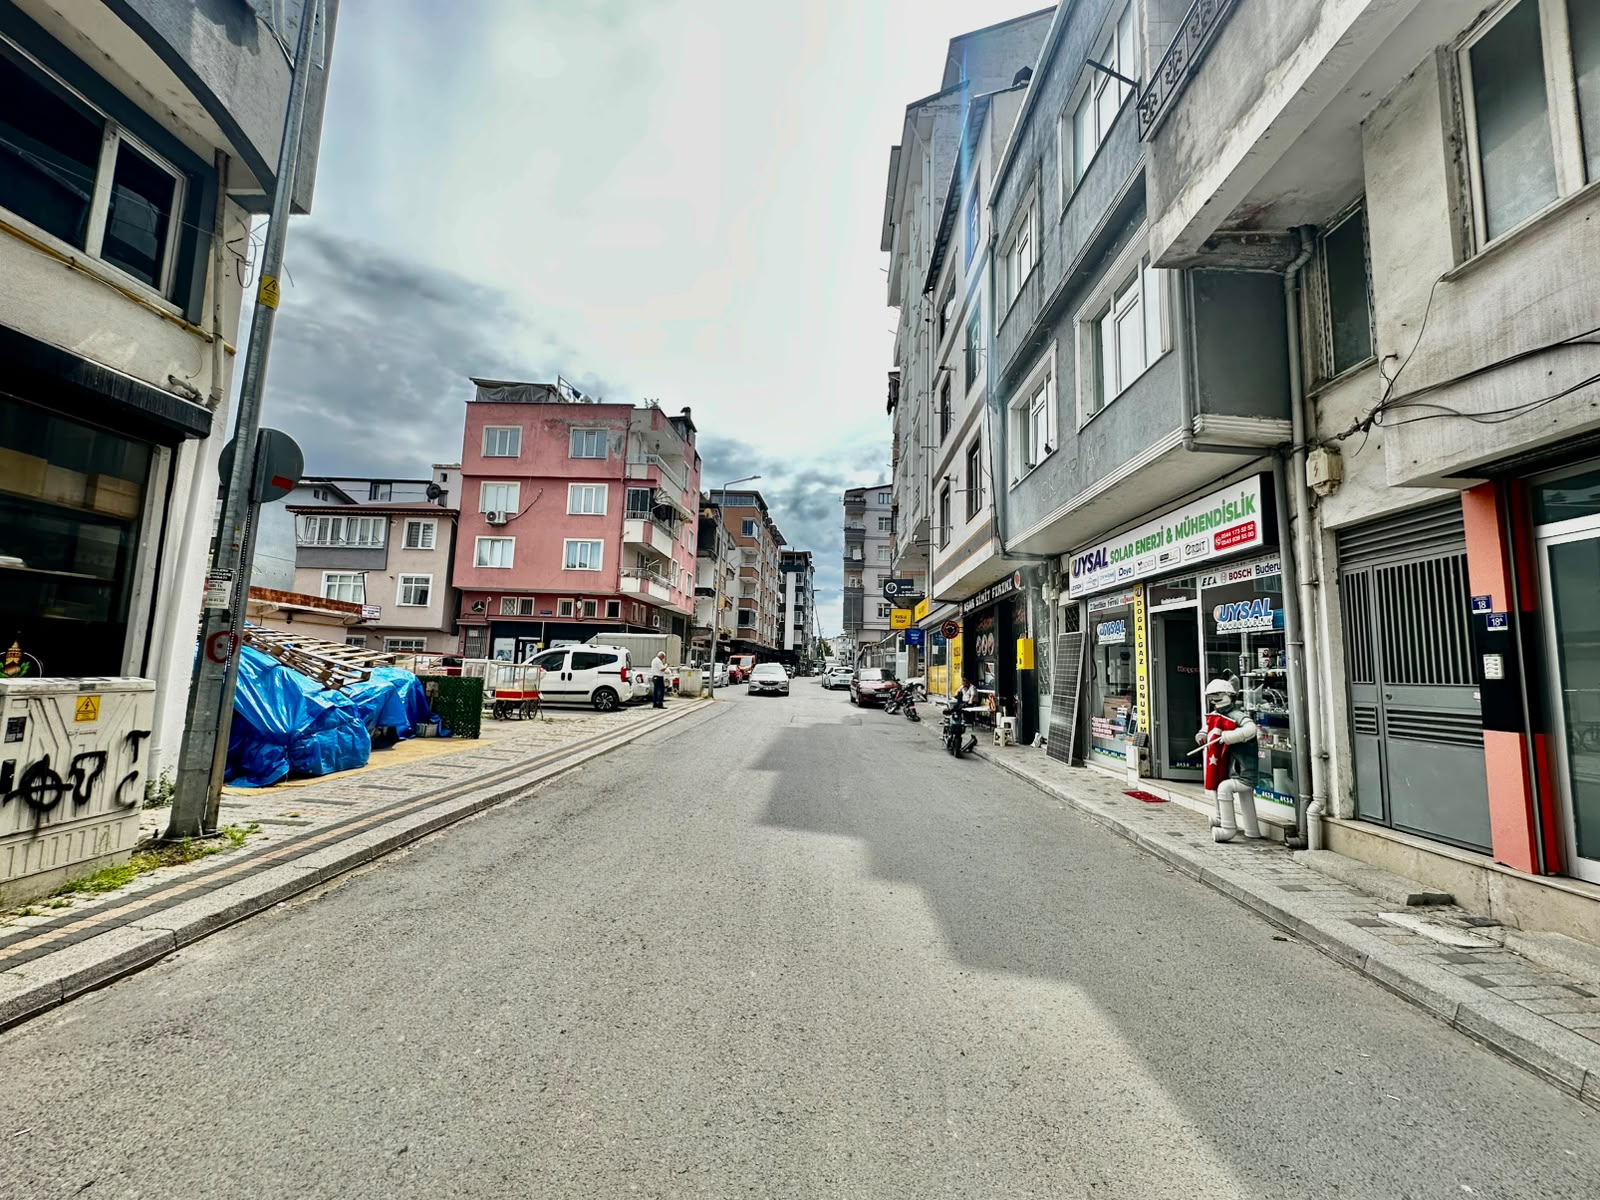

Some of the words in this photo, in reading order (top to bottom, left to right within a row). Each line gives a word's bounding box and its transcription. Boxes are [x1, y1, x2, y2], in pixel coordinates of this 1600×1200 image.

[1071, 547, 1109, 578] UYSAL
[1110, 543, 1134, 565] SOLAR
[1135, 525, 1164, 555] ENERJİ
[1166, 527, 1173, 544] &
[1175, 491, 1256, 541] MÜHENDİSLİK
[1228, 568, 1252, 581] BOSCH
[1255, 560, 1281, 575] Buderu
[1213, 597, 1274, 623] UYSAL
[1477, 600, 1487, 609] 18
[1097, 619, 1126, 637] UYSAL
